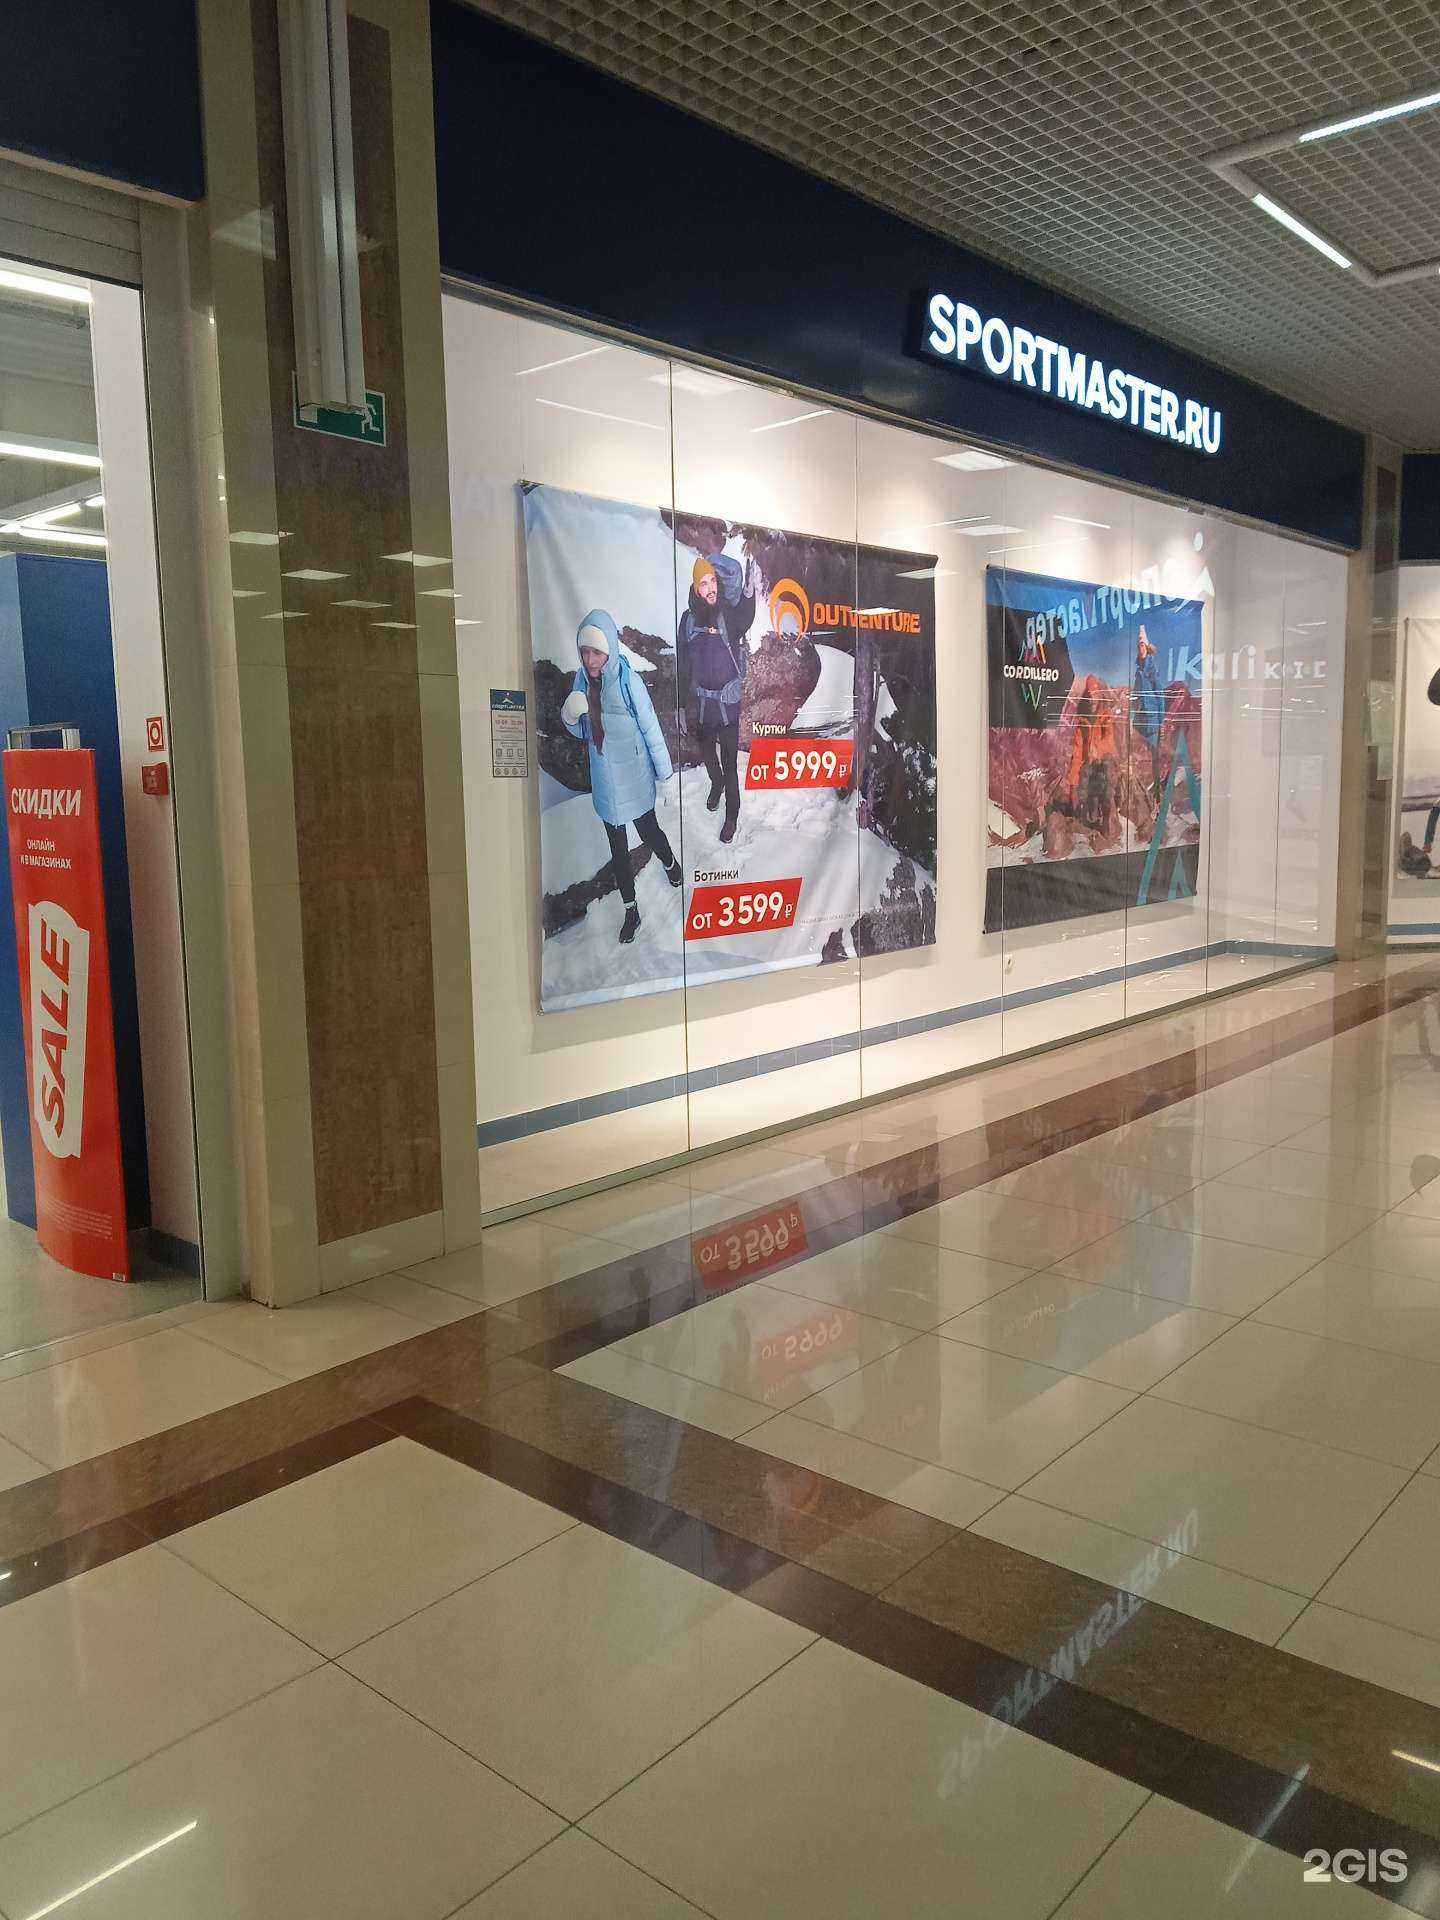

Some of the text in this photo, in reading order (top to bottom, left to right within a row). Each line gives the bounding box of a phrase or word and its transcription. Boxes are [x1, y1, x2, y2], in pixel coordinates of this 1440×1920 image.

[928, 292, 1222, 455] SPORTMASTER.RU
[813, 603, 921, 634] OUTVENTURE
[1003, 664, 1059, 682] CORDILLERO
[752, 722, 786, 737] Куртки
[11, 787, 81, 819] СКИДКИ
[26, 838, 55, 852] ОНЛАЙН
[29, 855, 72, 869] МАГАЗИНАХ
[694, 869, 739, 882] Ботинки
[41, 918, 70, 1138] SALE
